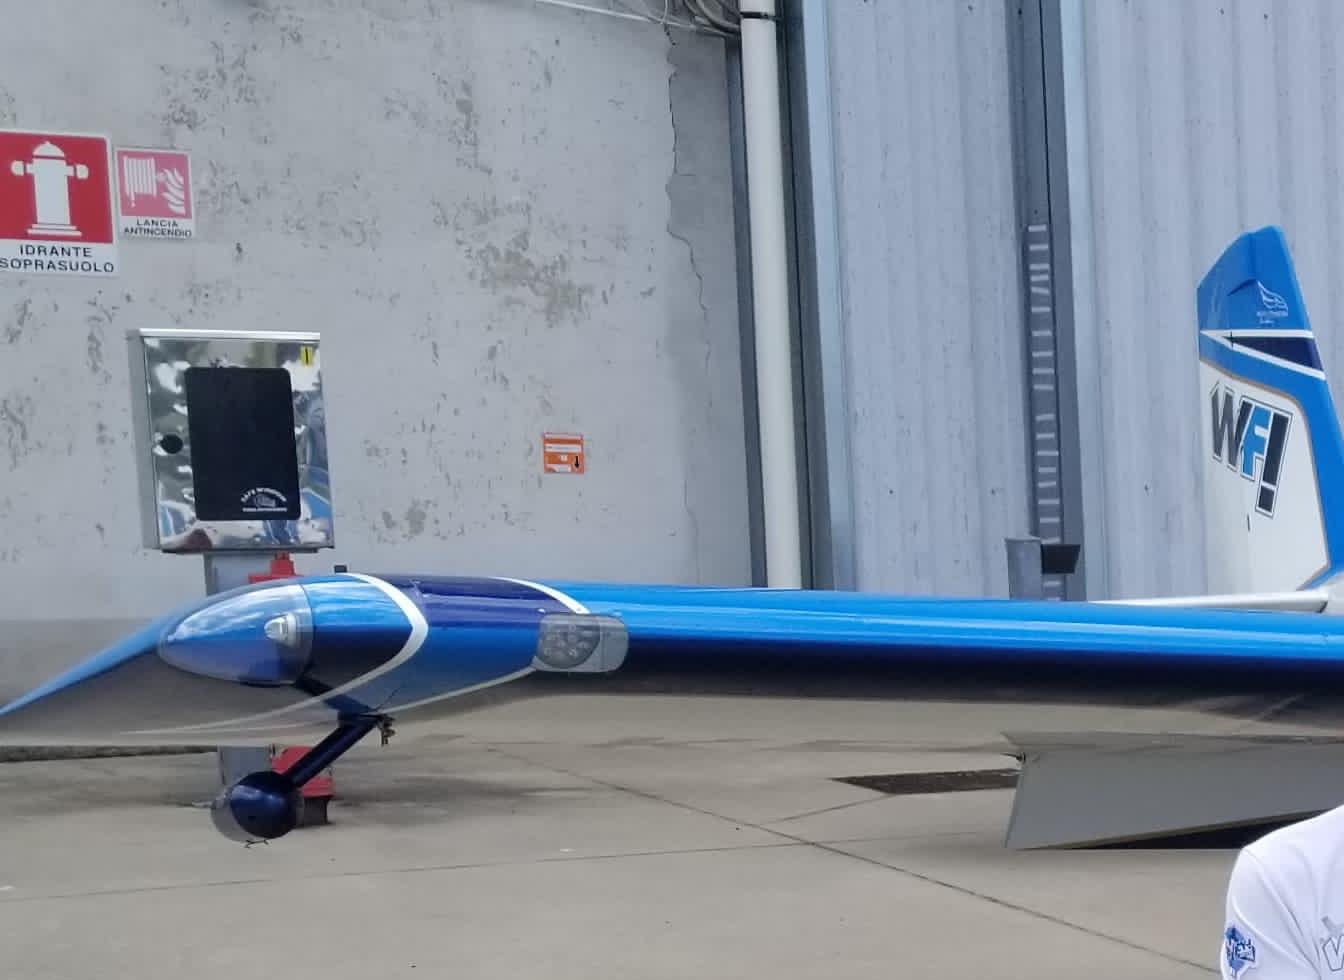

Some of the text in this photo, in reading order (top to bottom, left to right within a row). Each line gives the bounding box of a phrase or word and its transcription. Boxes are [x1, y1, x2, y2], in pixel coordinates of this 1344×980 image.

[136, 219, 179, 228] LANCIA
[124, 227, 192, 238] ANTINCENDIO
[20, 244, 93, 258] IDRANTE
[0, 257, 115, 273] SOPRASUOLO
[1209, 381, 1294, 520] WF!
